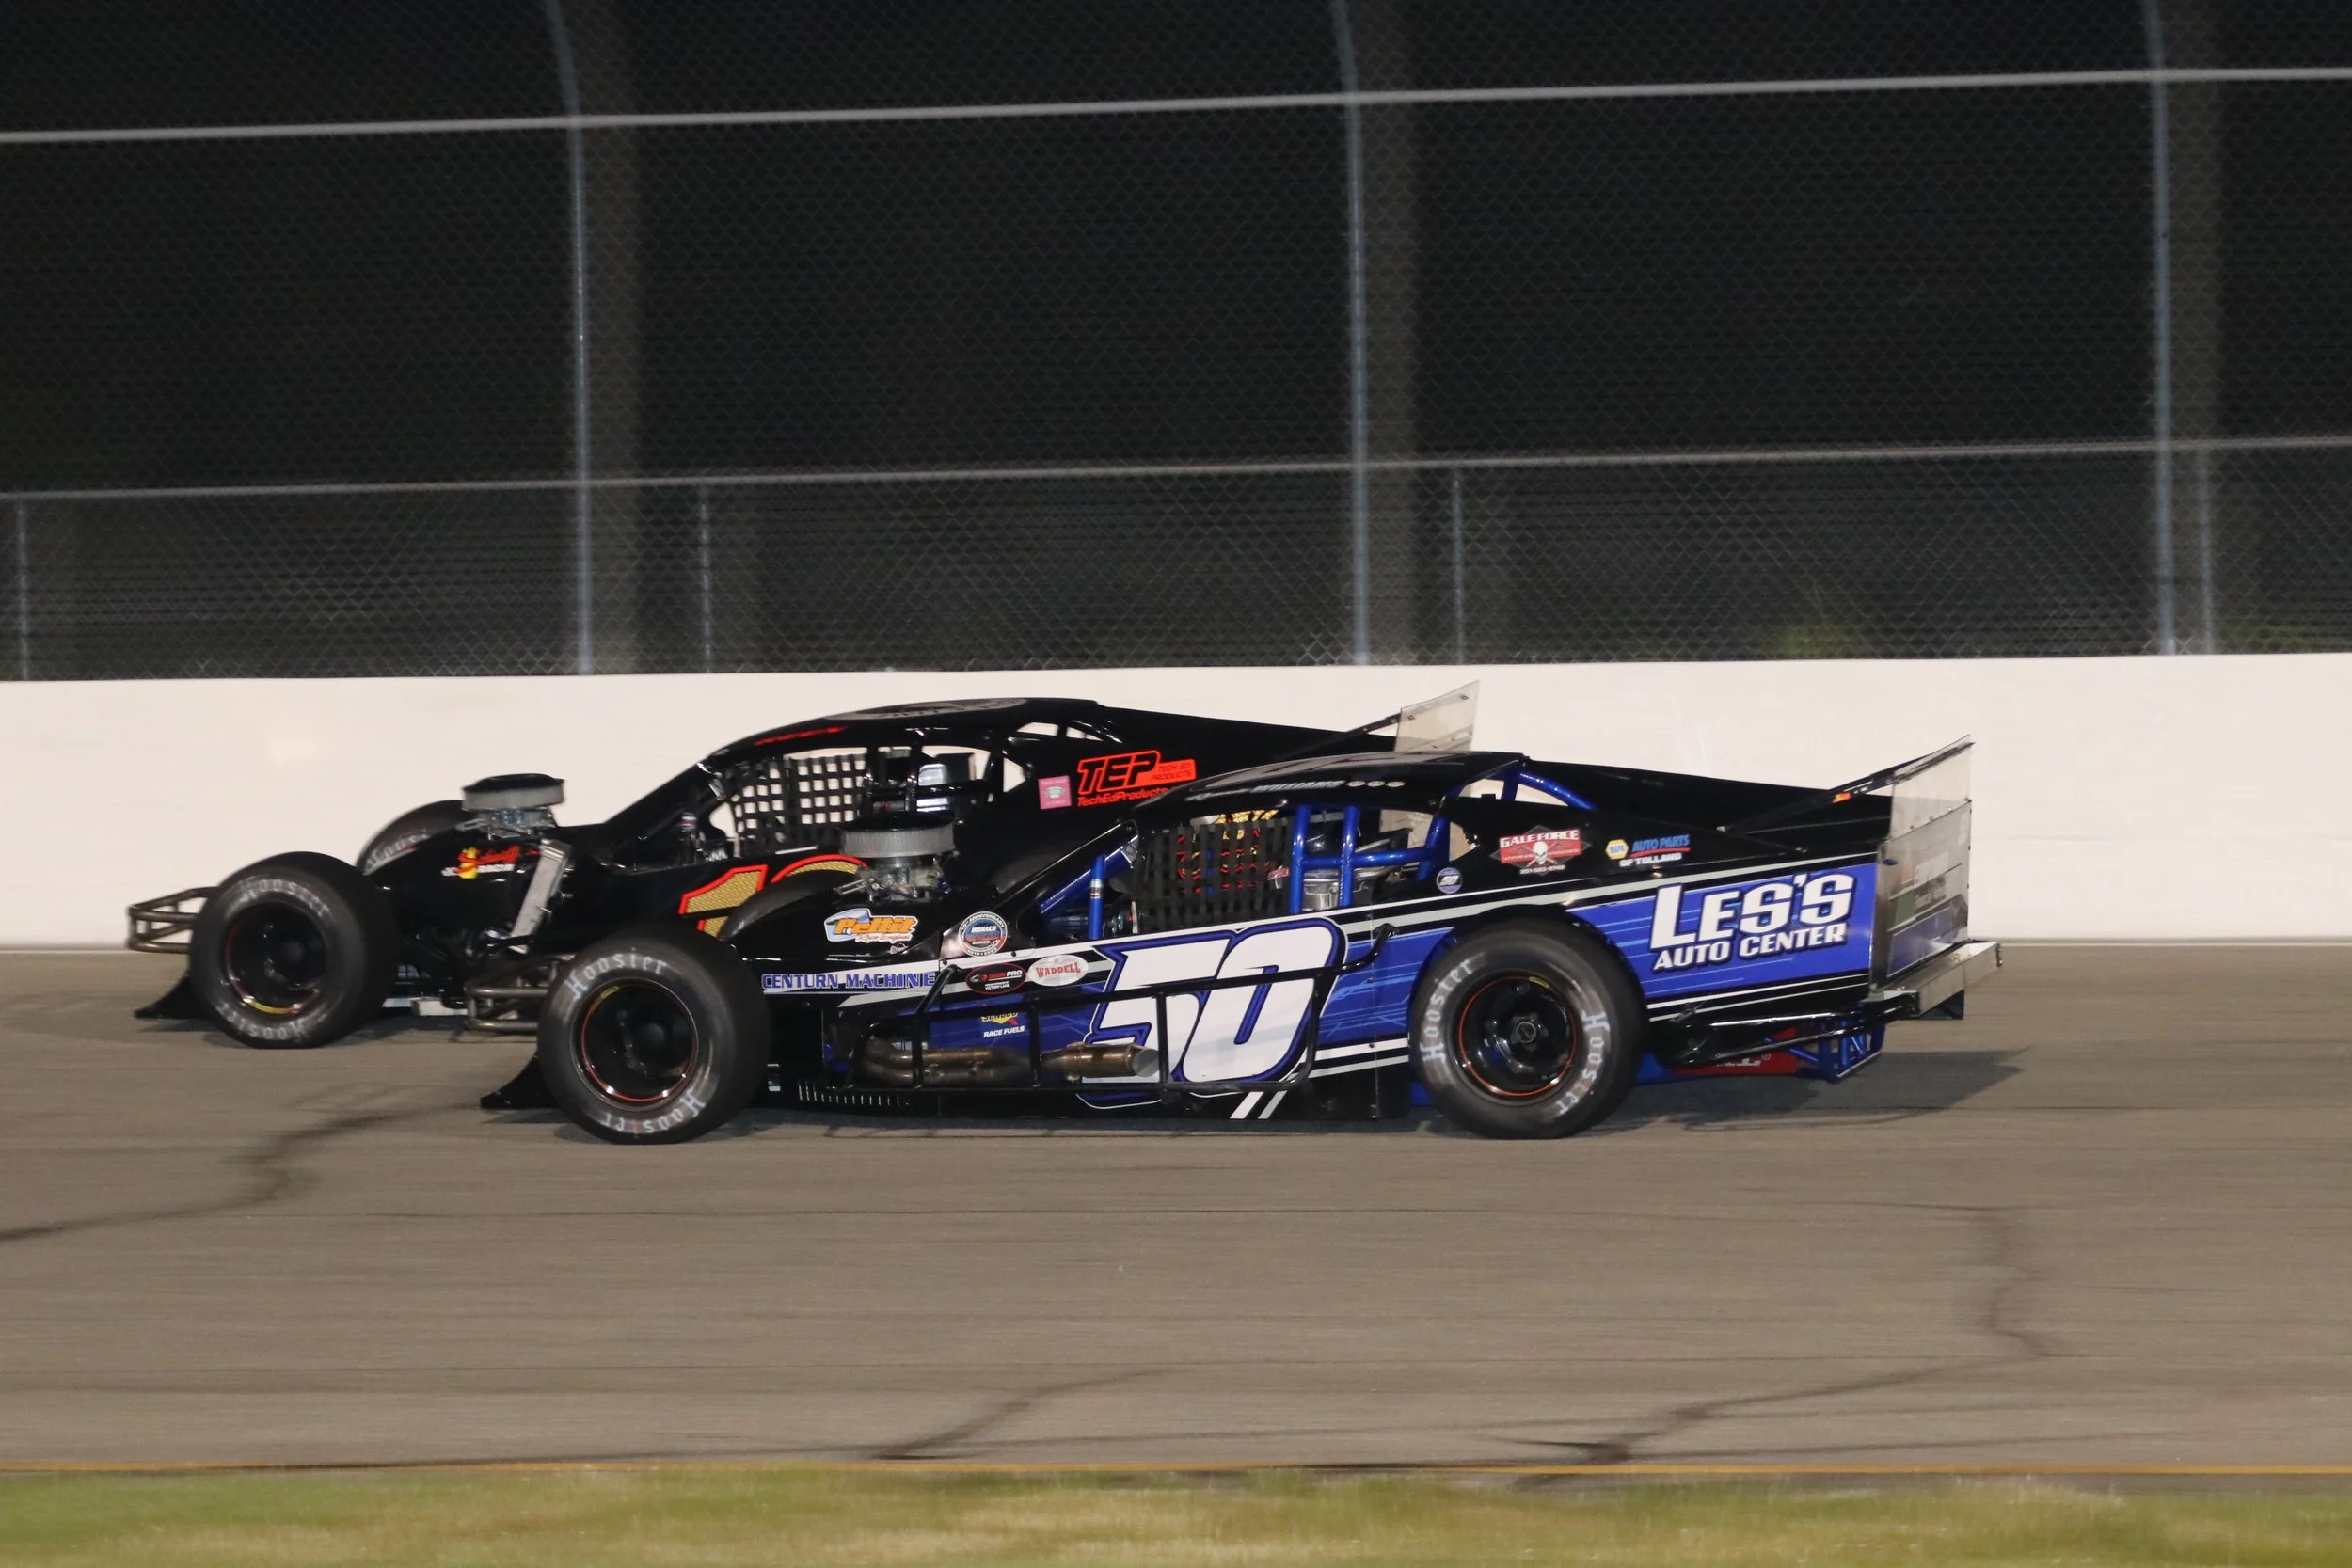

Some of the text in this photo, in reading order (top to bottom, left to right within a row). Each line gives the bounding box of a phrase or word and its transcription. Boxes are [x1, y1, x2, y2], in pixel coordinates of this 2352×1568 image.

[1078, 751, 1160, 794] TEP
[1500, 829, 1580, 848] GALE FORCE
[1619, 852, 1682, 867] OF TOLLAND
[1631, 838, 1659, 852] AUTO
[1660, 834, 1690, 847] PARTS
[1650, 872, 1854, 949] LES'S
[1653, 922, 1848, 971] AUTO CENTER
[564, 947, 668, 1001] Hoosier
[845, 972, 936, 989] MACHINE
[1036, 962, 1081, 979] WADDELL
[1082, 917, 1336, 1099] 50
[1419, 958, 1473, 1063] Hoosier
[983, 1025, 1025, 1038] RACE FUELS
[1554, 1010, 1611, 1115] Hoosier
[600, 1087, 705, 1138] Hoosier
